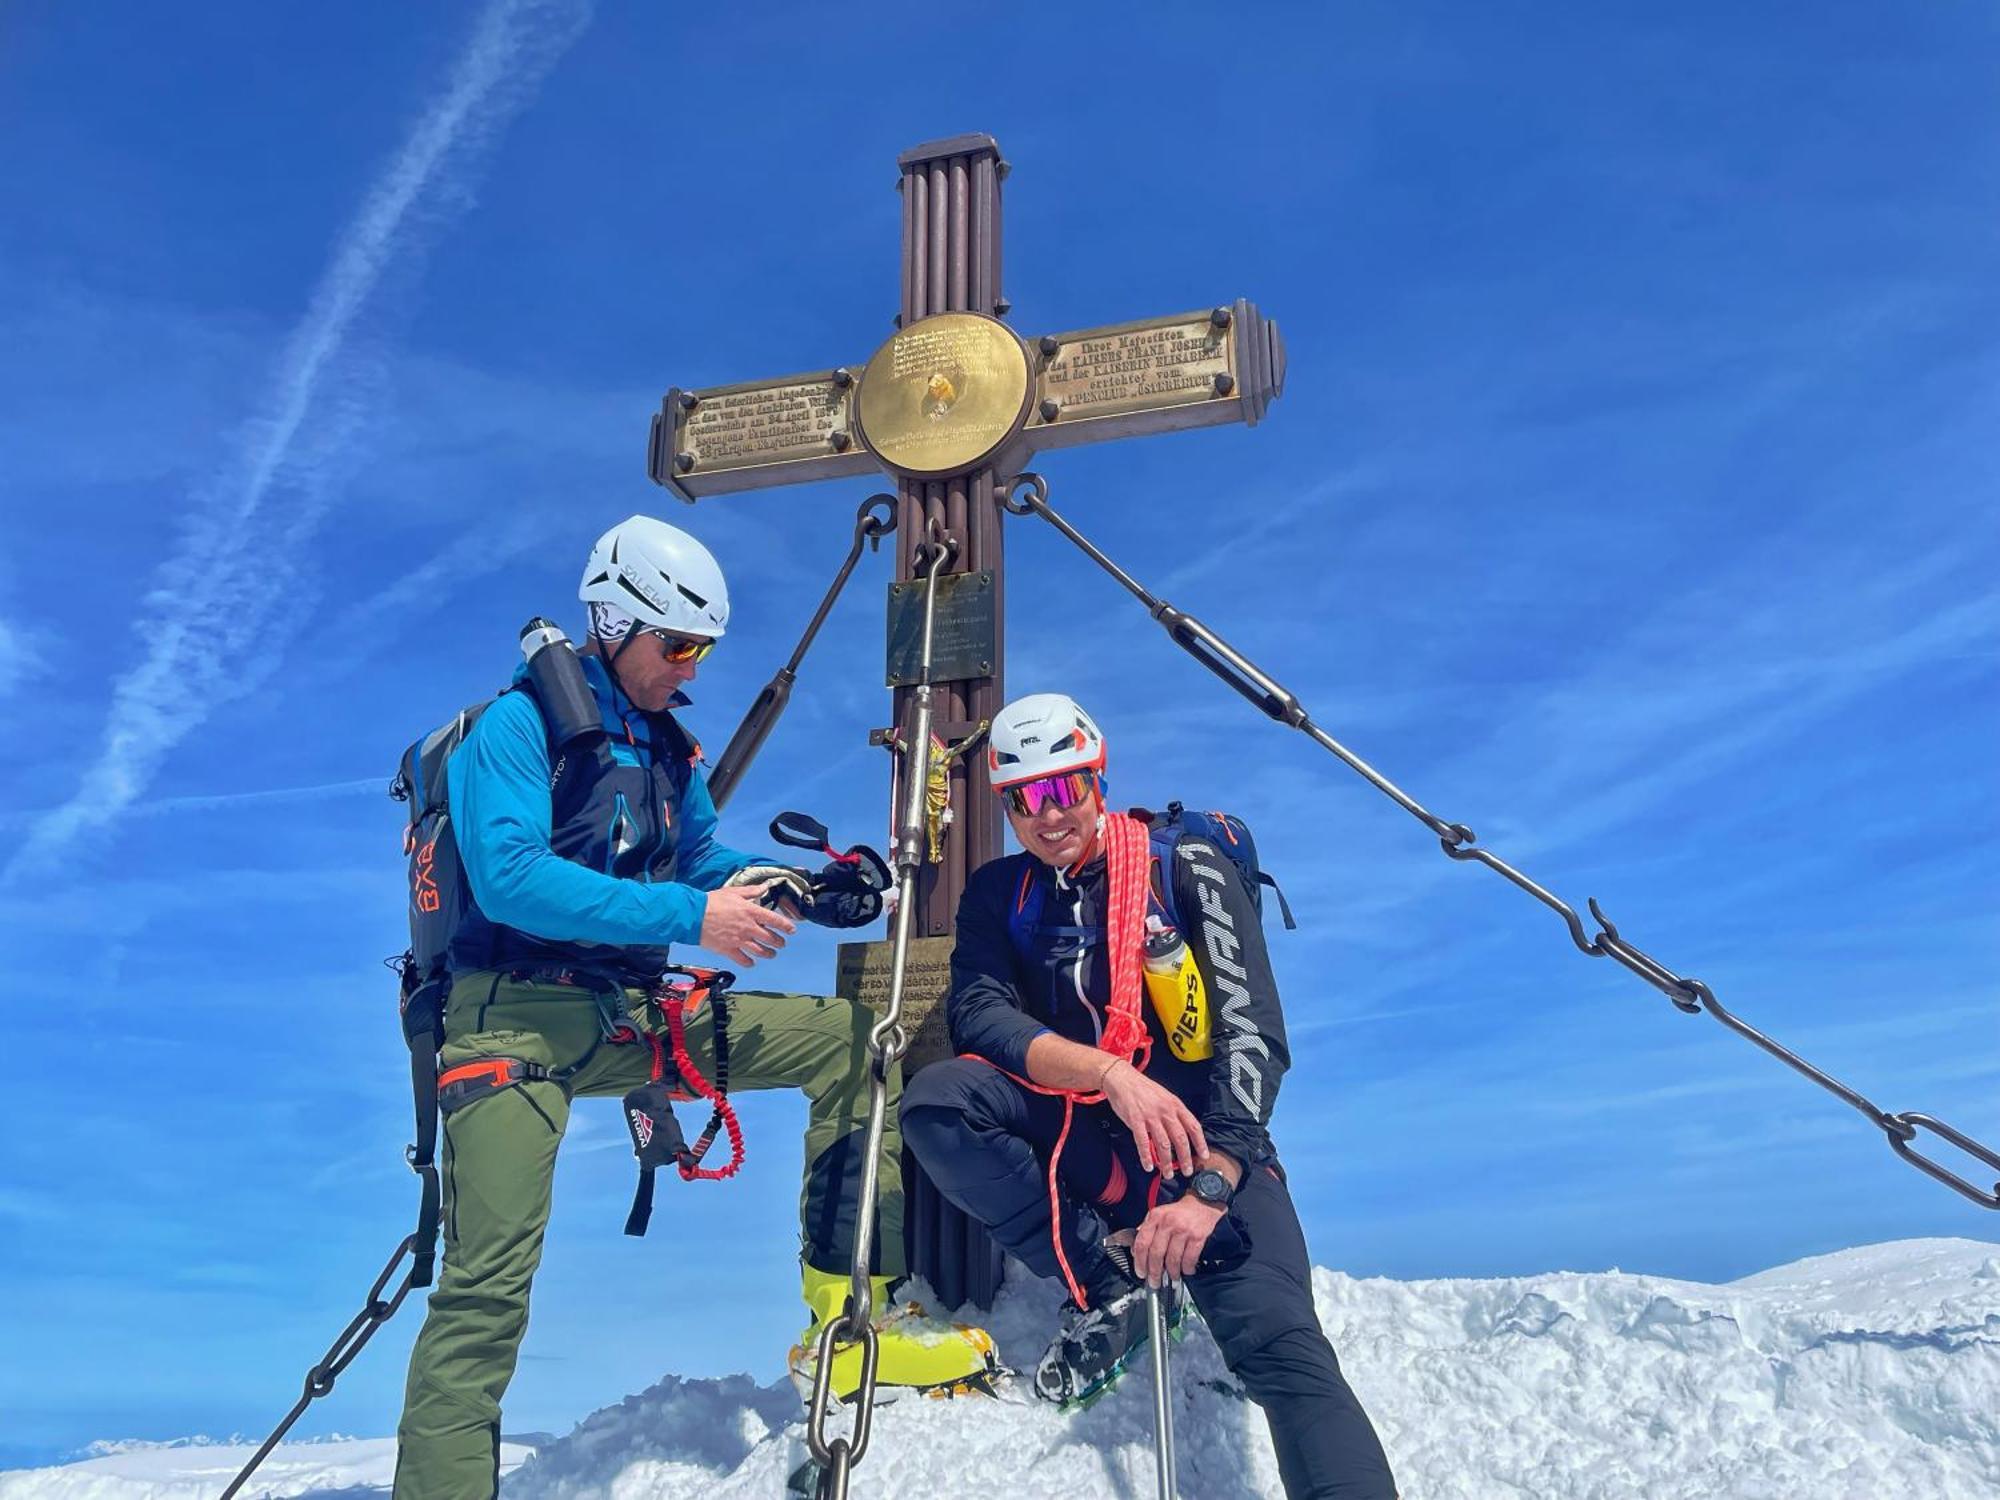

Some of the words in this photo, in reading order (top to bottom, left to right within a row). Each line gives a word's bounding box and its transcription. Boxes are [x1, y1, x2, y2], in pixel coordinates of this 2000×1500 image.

[1093, 359, 1151, 378] KAISERIN
[620, 564, 671, 612] SALEWA
[1171, 973, 1198, 1055] PIEPS
[1176, 842, 1270, 1123] DYNAFIT
